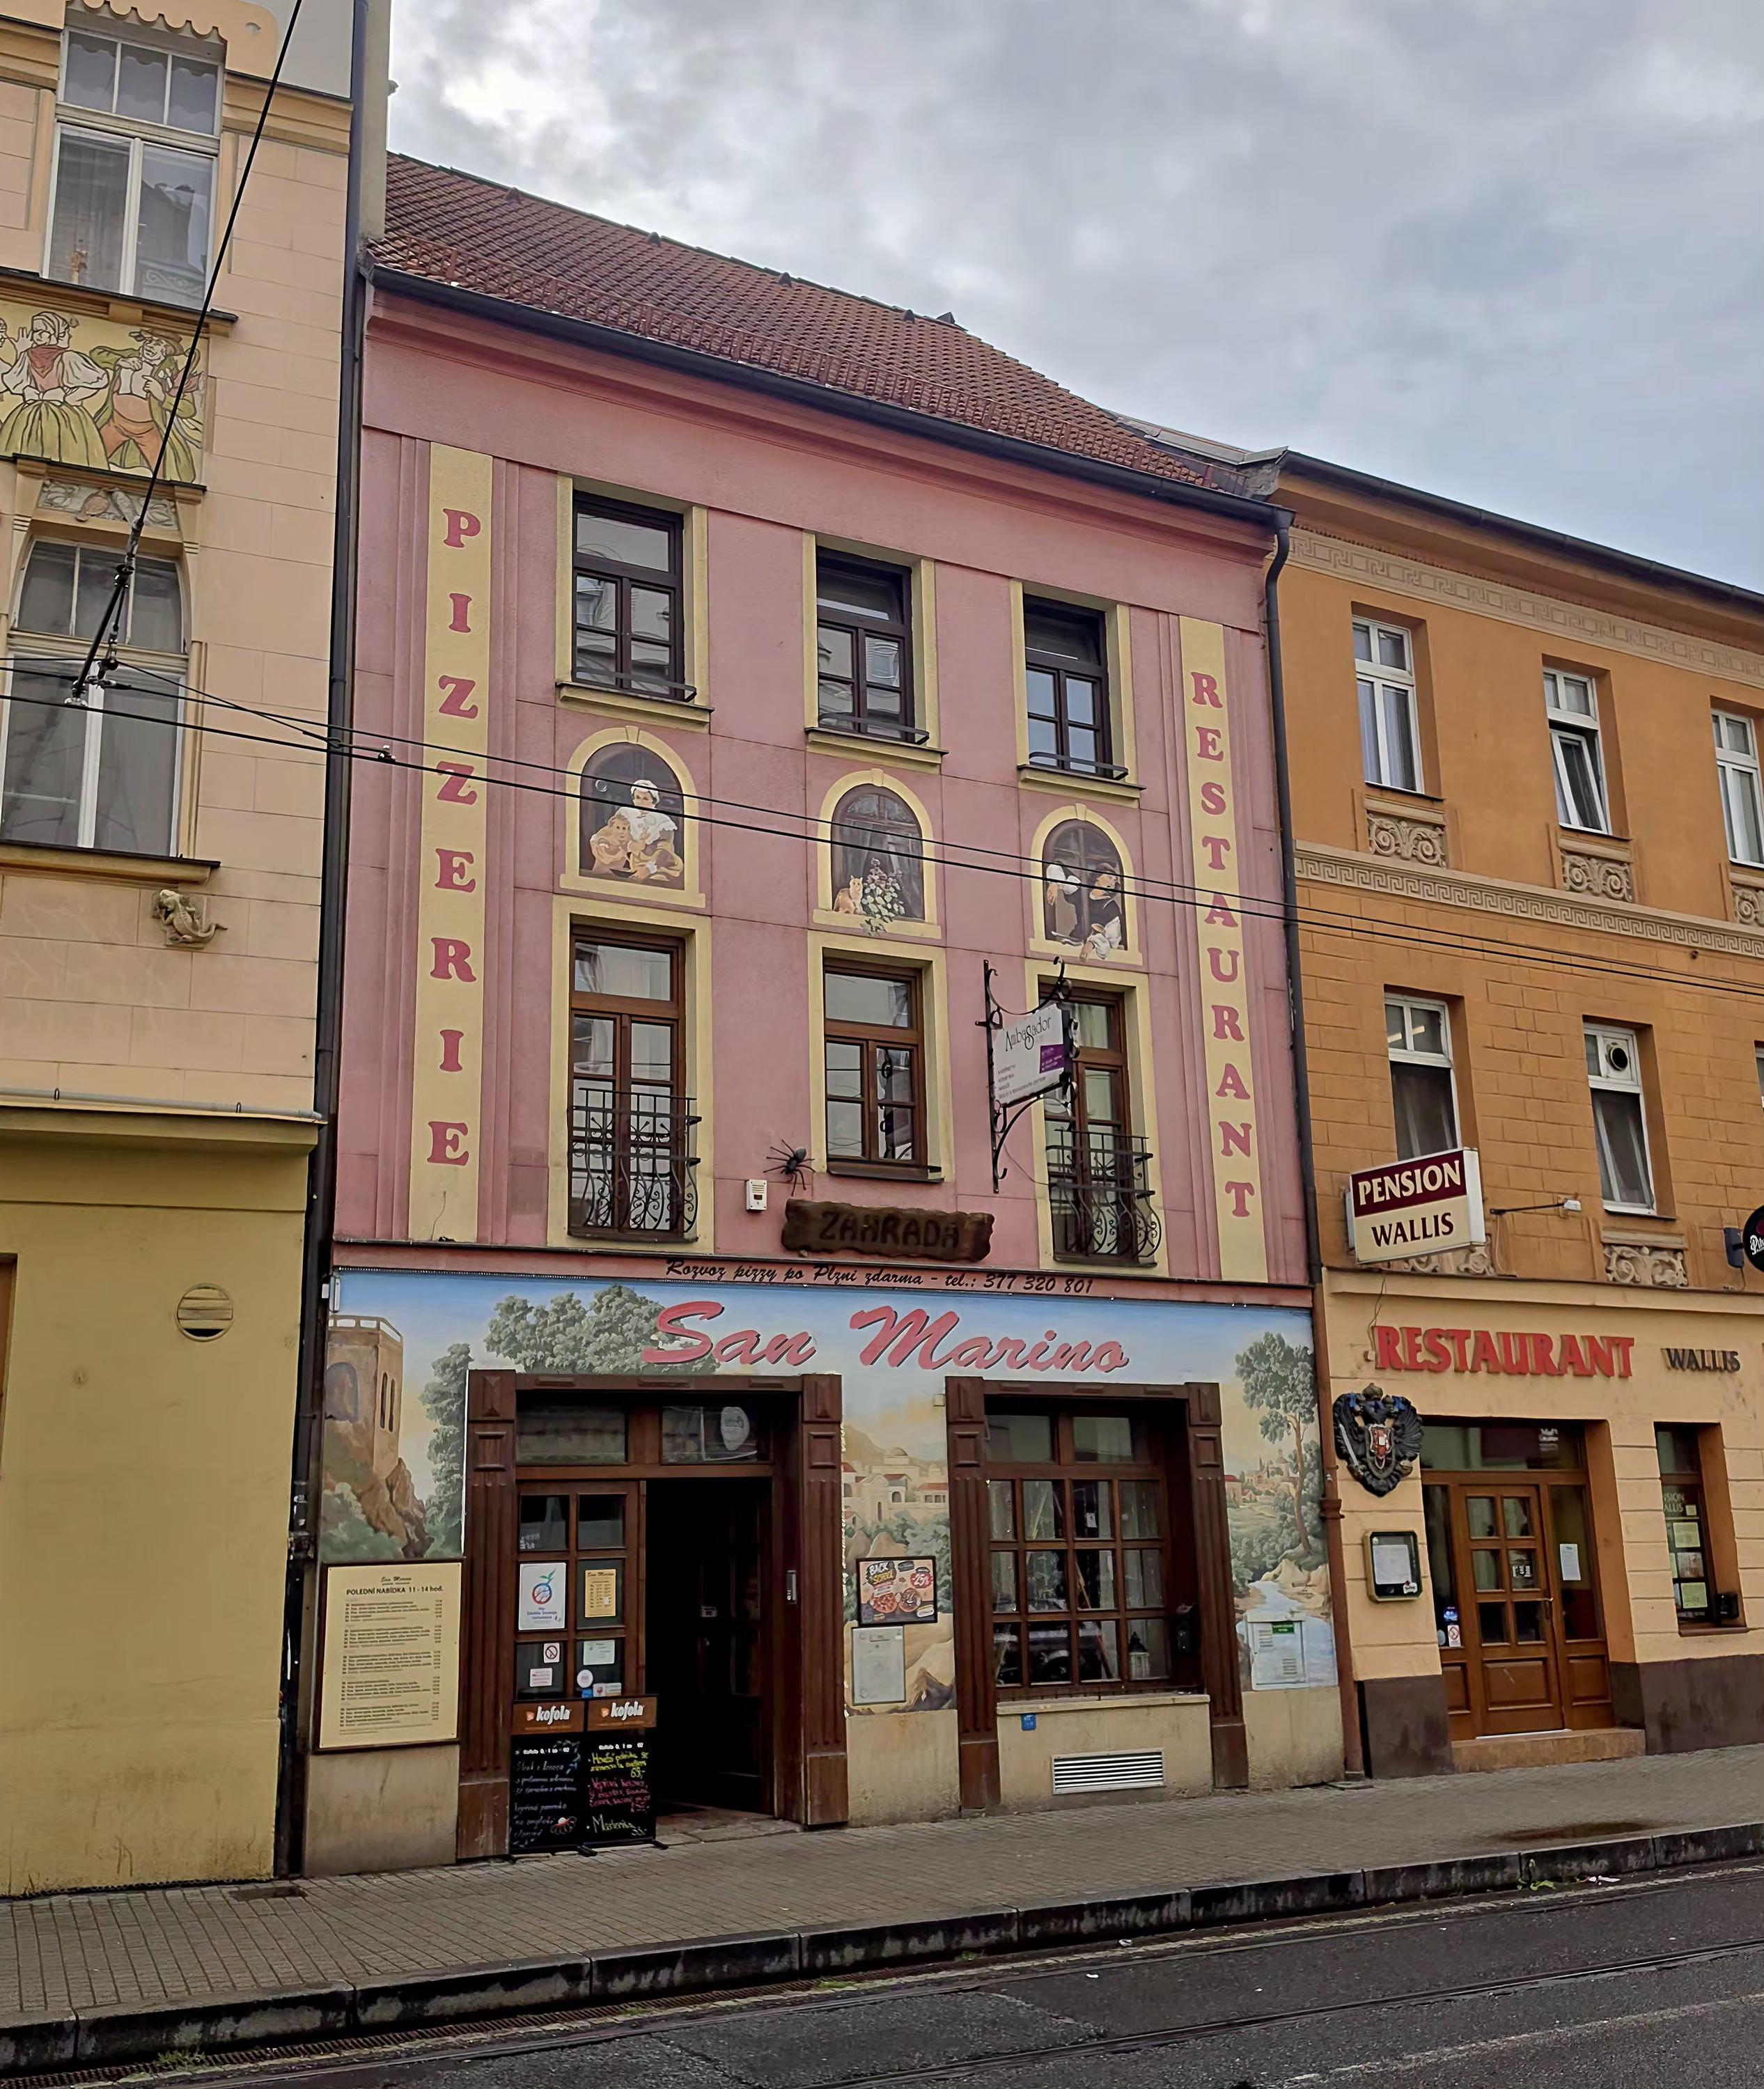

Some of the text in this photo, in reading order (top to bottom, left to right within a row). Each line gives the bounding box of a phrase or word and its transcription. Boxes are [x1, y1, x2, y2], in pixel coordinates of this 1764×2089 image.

[430, 508, 481, 1166] PIZZERIE
[1192, 673, 1252, 1216] RESTAURANT
[1358, 1160, 1461, 1206] PENSION
[1371, 1212, 1454, 1247] WALLIS
[666, 1258, 726, 1281] Rozvoz
[733, 1264, 778, 1282] pizzy
[783, 1267, 804, 1282] po
[813, 1263, 857, 1285] Plzni
[864, 1269, 924, 1286] zdarma
[945, 1273, 976, 1288] tel.:
[983, 1273, 1015, 1289] 377
[1023, 1275, 1056, 1292] 320
[1063, 1278, 1095, 1294] 801
[641, 1300, 1130, 1373] San Marino
[1373, 1325, 1635, 1379] RESTAURANT
[1660, 1347, 1741, 1374] WALLIS
[1663, 1503, 1684, 1513] ALLIS
[1664, 1493, 1685, 1503] SION
[346, 1586, 376, 1596] POLEDNÍ
[376, 1586, 406, 1595] NABÍDKA
[536, 1705, 570, 1726] kofola
[611, 1700, 644, 1721] kofola
